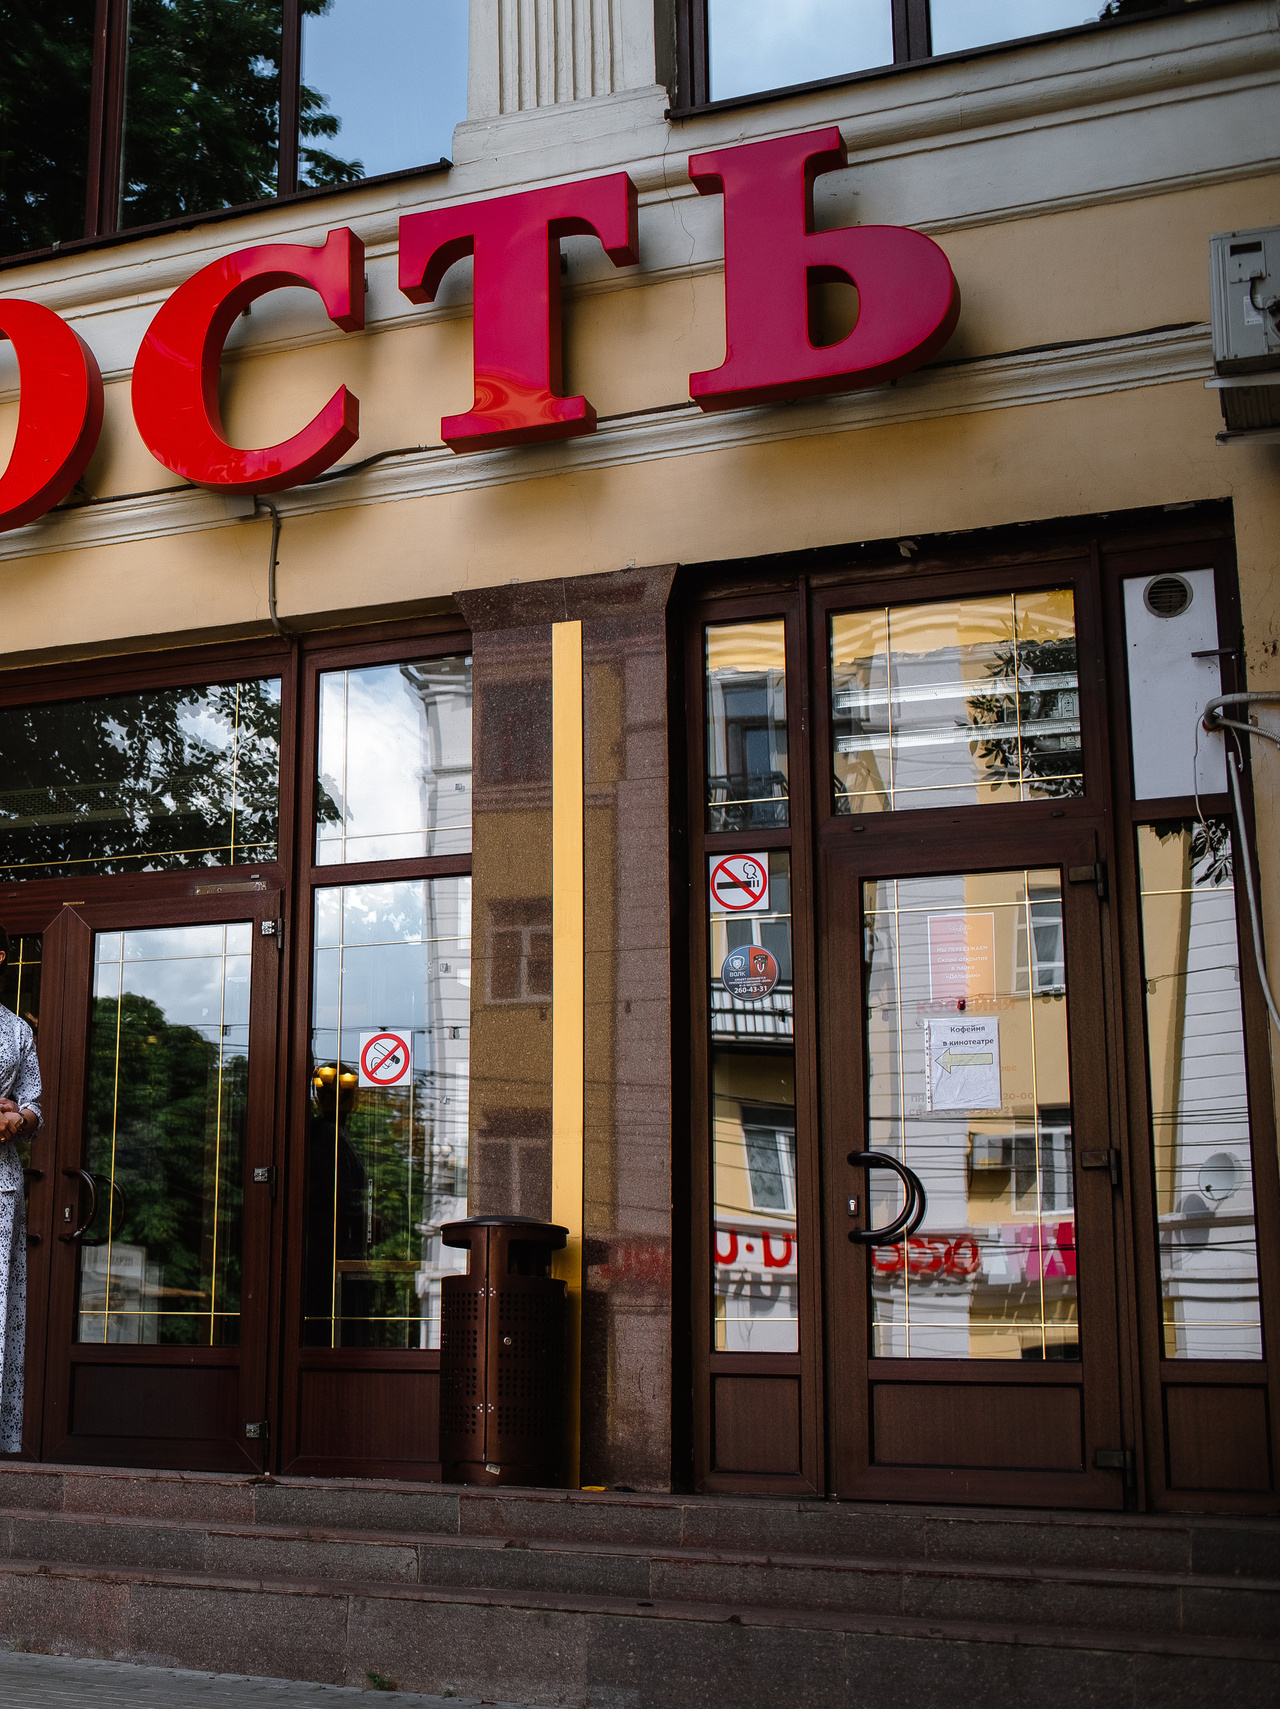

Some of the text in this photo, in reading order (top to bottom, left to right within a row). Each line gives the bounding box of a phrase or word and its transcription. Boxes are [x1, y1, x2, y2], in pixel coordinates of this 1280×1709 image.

[734, 985, 767, 993] 260-43-31
[950, 1024, 986, 1034] Кофейня
[949, 1037, 995, 1047] кинотеатре
